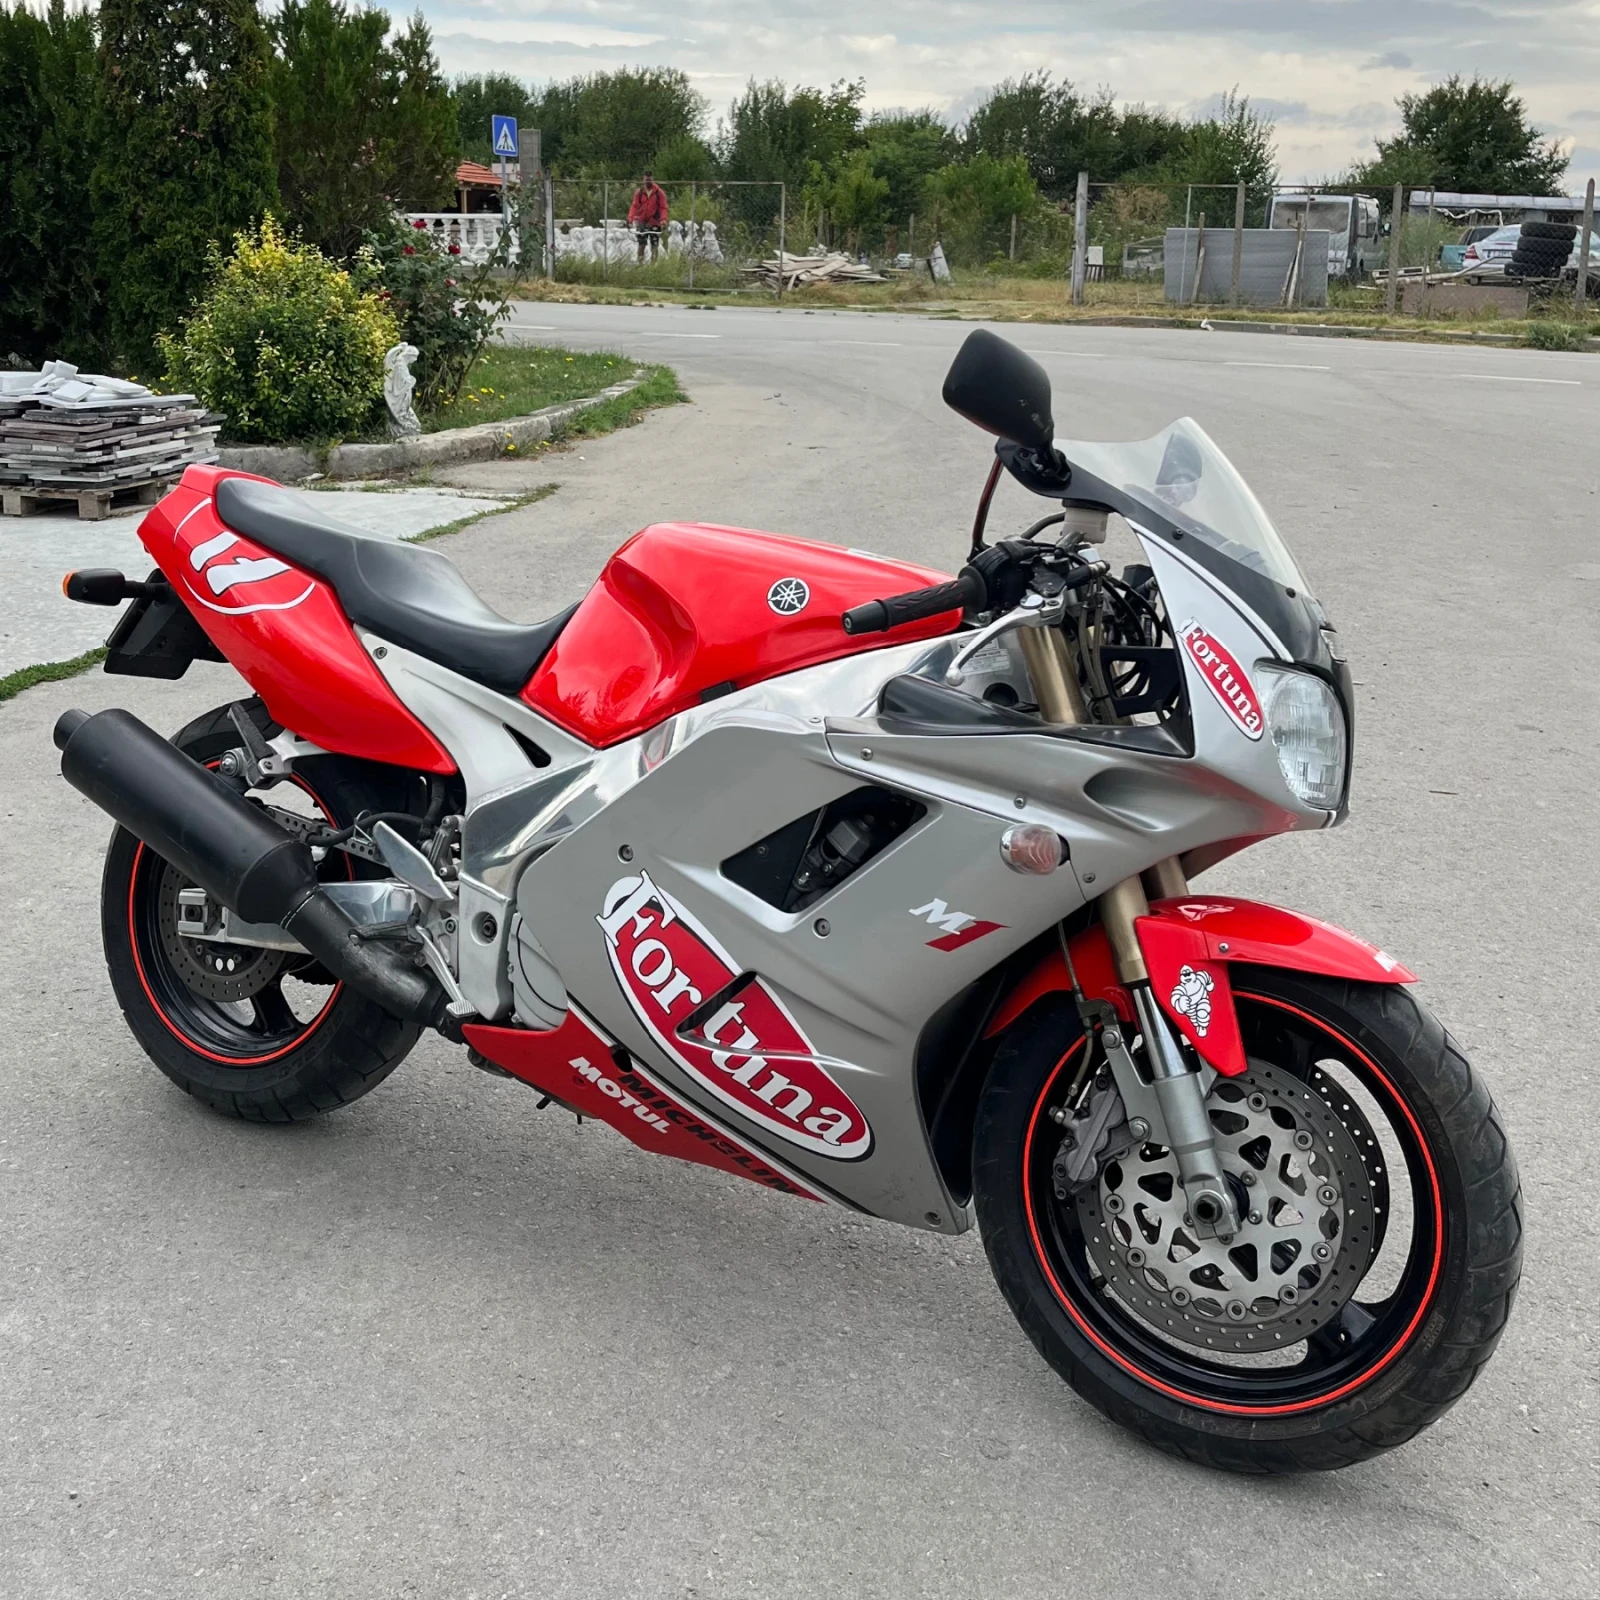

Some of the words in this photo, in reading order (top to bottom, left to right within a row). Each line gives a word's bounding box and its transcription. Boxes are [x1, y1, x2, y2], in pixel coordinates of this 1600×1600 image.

[1176, 616, 1261, 734] Fortuna
[595, 868, 853, 1147] Fortuna
[568, 1056, 671, 1134] MOTUL
[618, 1074, 800, 1194] MICHELIN
